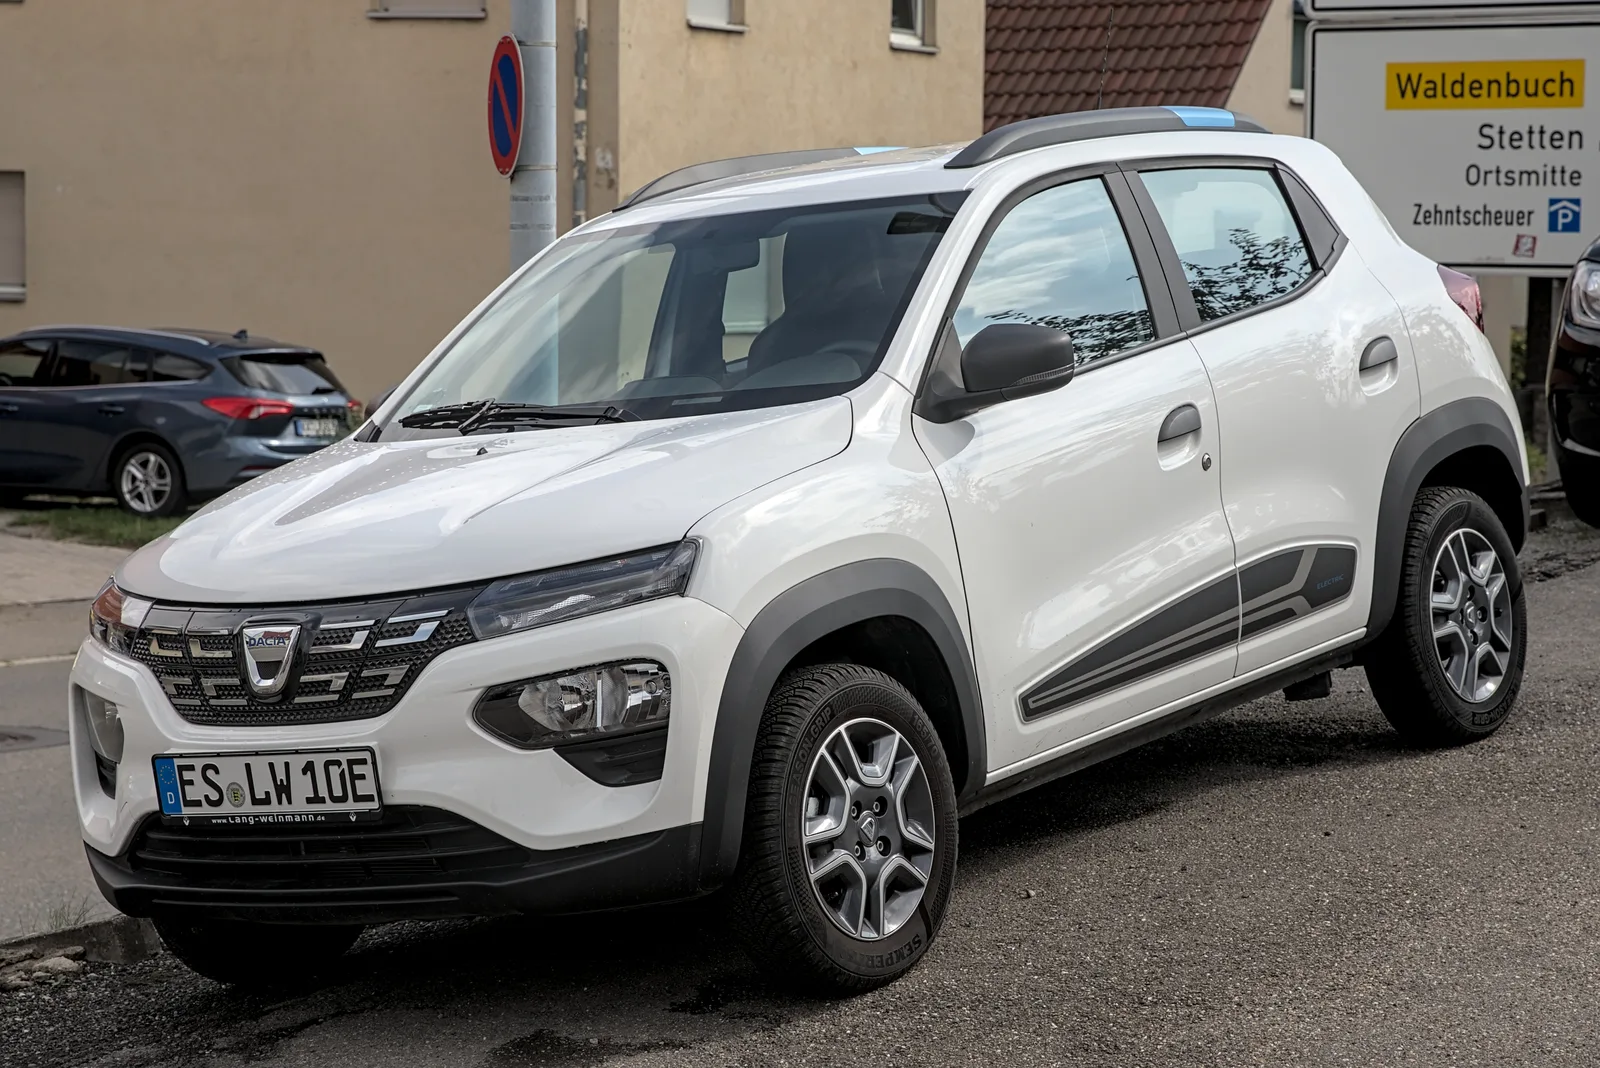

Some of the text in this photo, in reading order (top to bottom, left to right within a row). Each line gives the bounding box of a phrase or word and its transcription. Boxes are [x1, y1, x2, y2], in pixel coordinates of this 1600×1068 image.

[1395, 70, 1575, 99] Waldenbuch
[1477, 123, 1584, 150] Stetten
[1465, 163, 1583, 187] Ortsmitte
[1413, 203, 1535, 227] Zehntscheuer
[1557, 209, 1573, 231] P
[1316, 573, 1344, 590] ELECTRIC
[248, 636, 287, 647] DACIA
[176, 763, 225, 808] ES
[244, 761, 293, 806] LW
[301, 758, 376, 805] 10E
[166, 791, 175, 805] D
